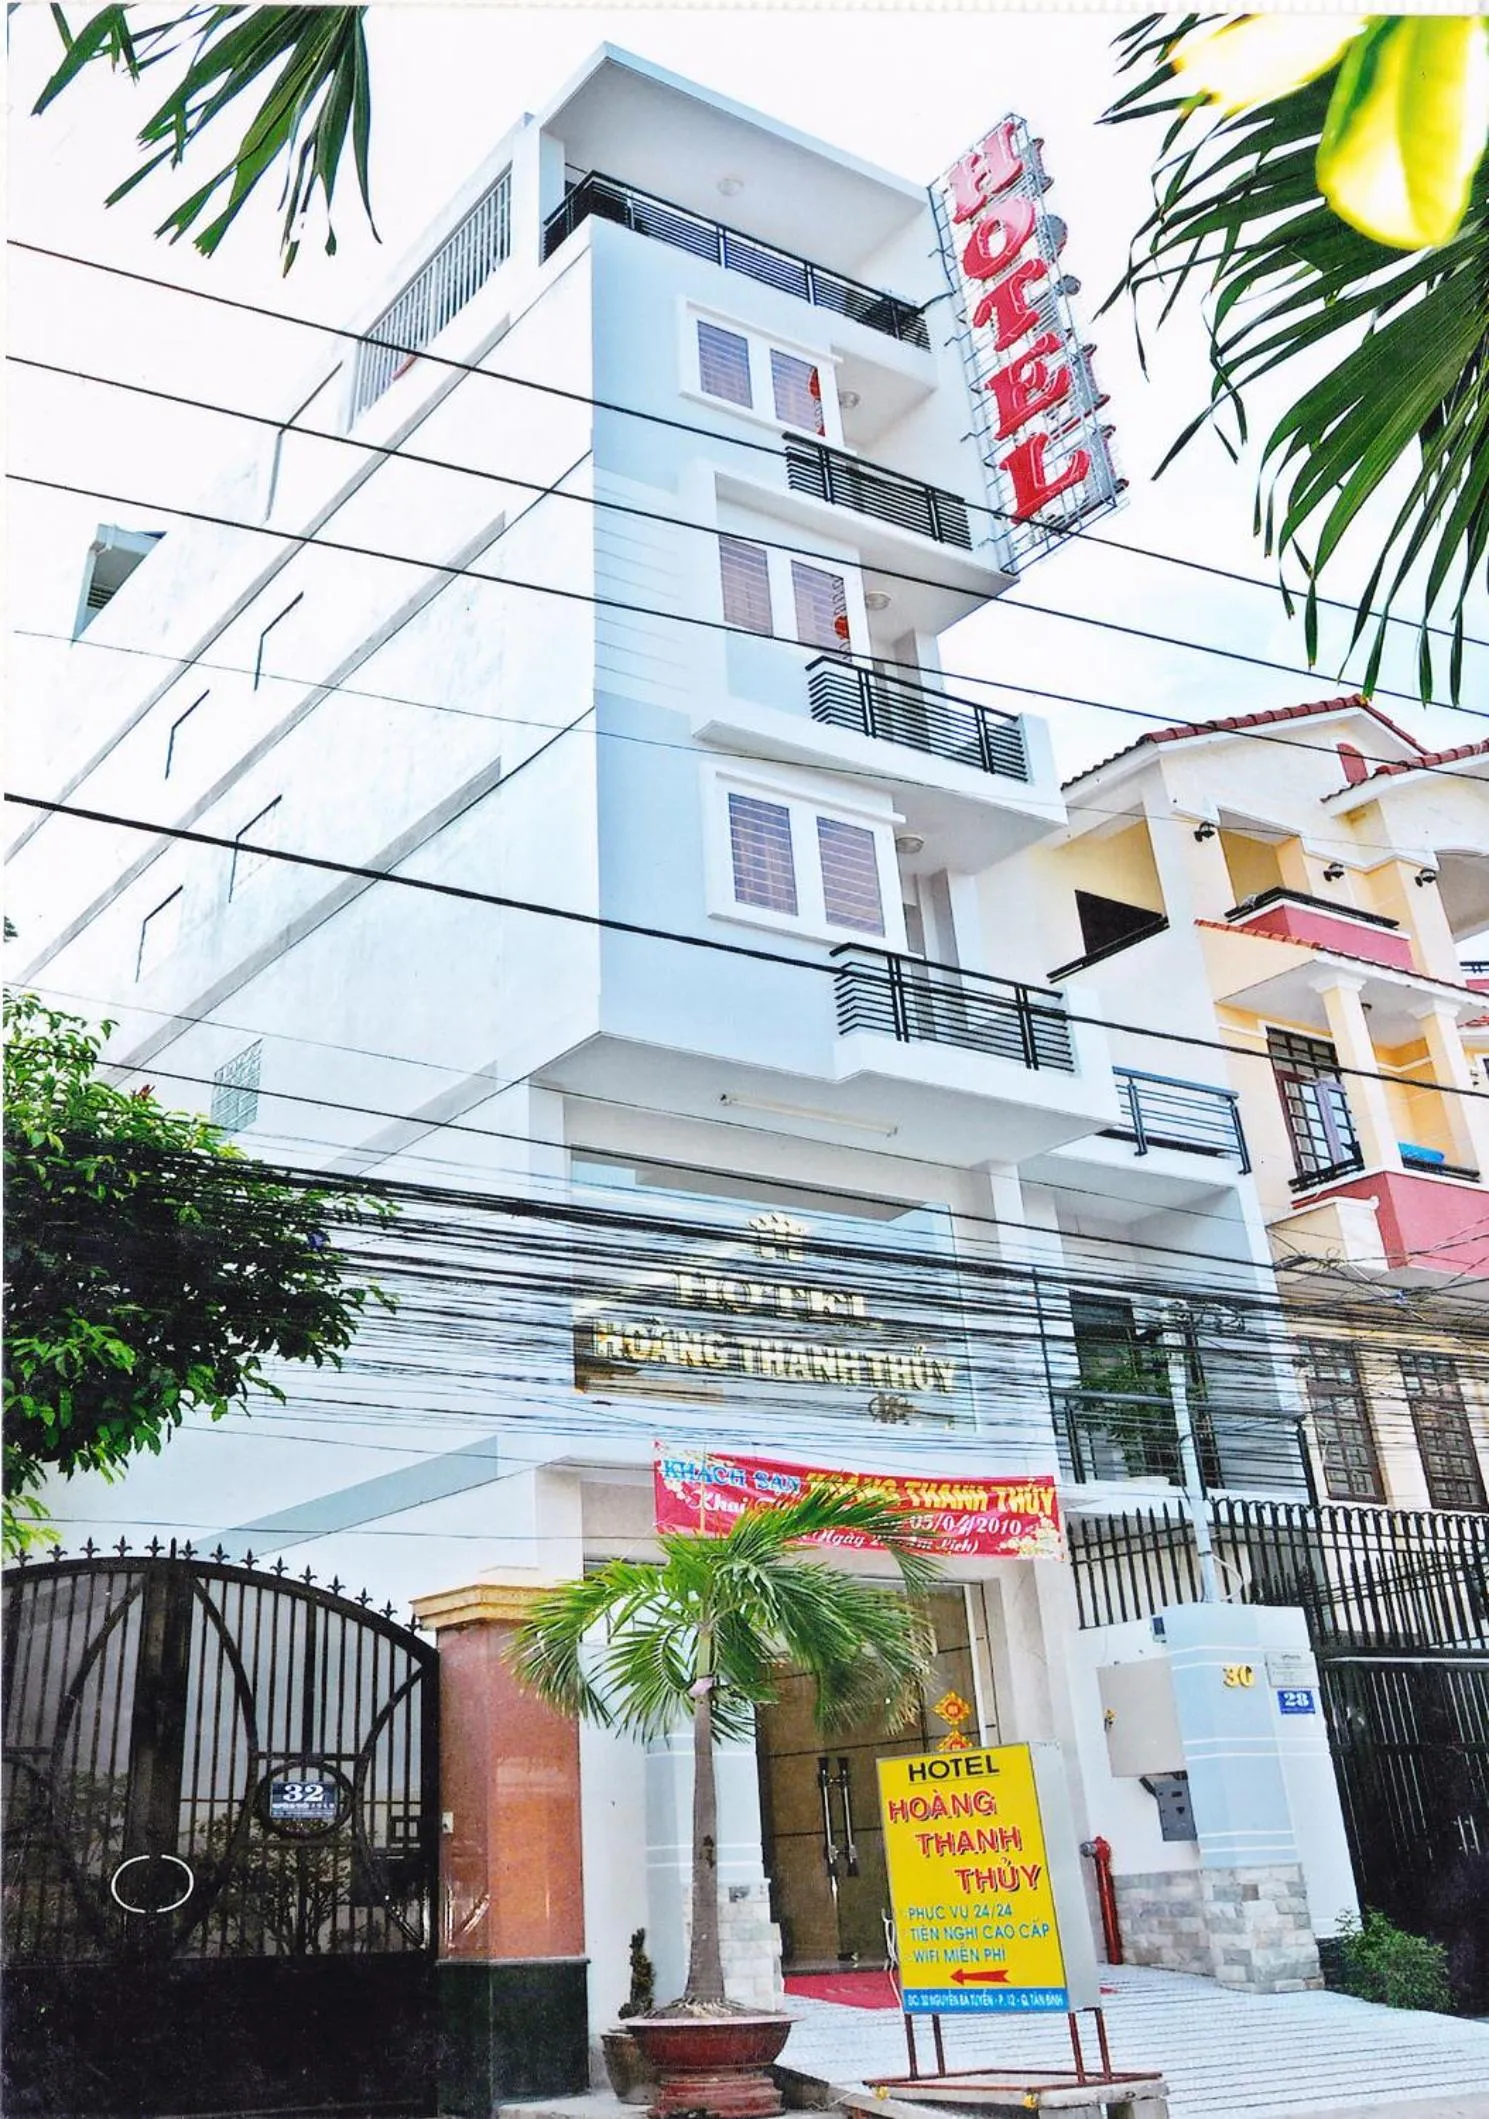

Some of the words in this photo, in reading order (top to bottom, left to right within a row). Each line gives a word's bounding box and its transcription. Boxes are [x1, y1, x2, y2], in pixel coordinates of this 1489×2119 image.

[949, 121, 1091, 526] HOTEL
[904, 1481, 989, 1513] THANH
[1283, 1691, 1311, 1708] 28
[908, 1754, 1000, 1782] HOTEL
[282, 1783, 324, 1802] 32
[887, 1788, 998, 1825] HOÀNG
[915, 1825, 1023, 1858] THANH
[954, 1856, 1042, 1894] THỦY
[974, 1903, 1013, 1919] 24/24
[982, 1923, 1016, 1939] CAO
